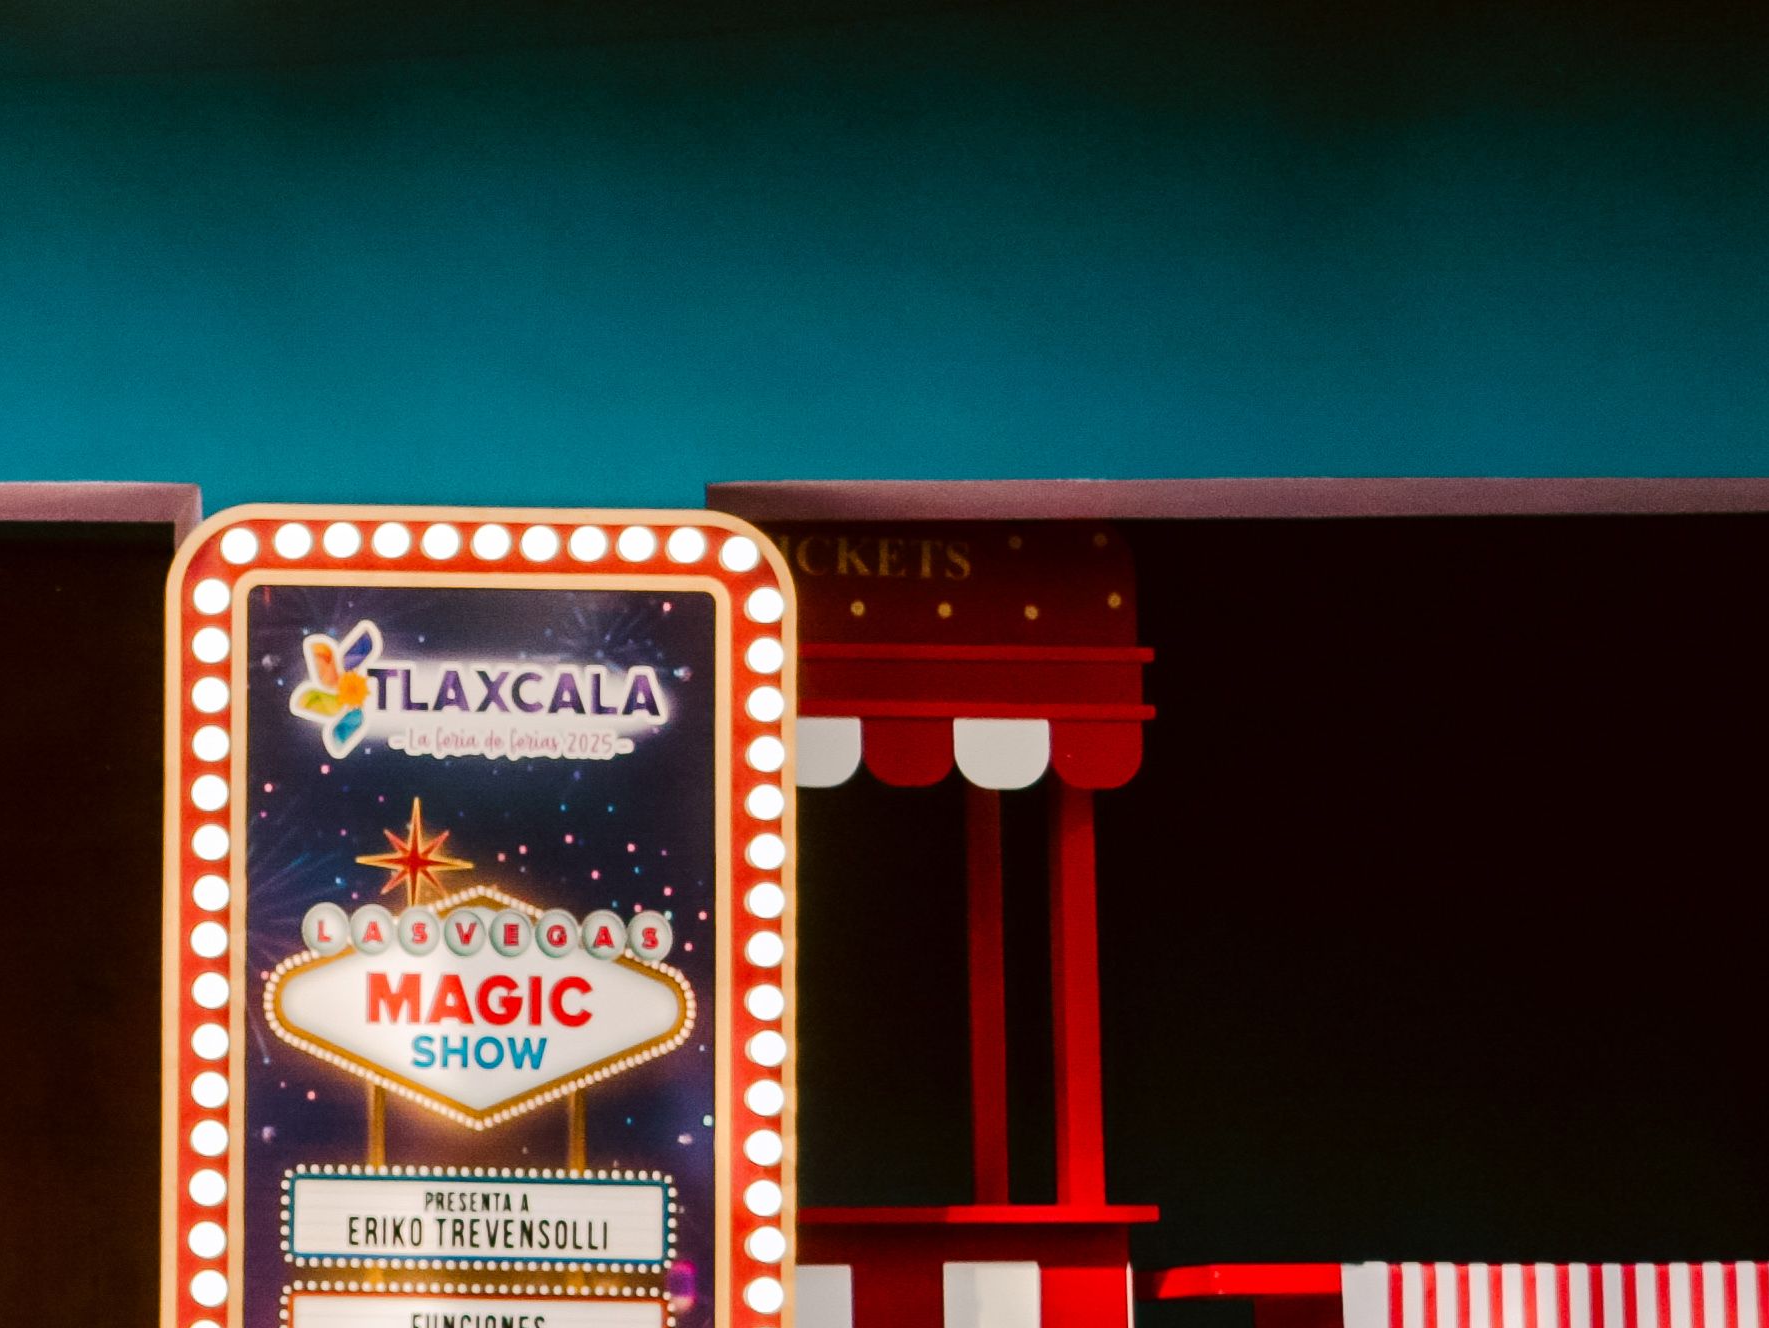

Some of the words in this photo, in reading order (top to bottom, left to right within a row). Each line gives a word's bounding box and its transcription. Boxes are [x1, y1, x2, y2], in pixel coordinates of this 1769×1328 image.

[778, 534, 972, 581] ICKETS
[367, 668, 662, 717] TLAXCALA
[409, 728, 429, 749] La
[436, 726, 478, 753] feria
[484, 729, 502, 752] de
[510, 729, 559, 753] ferias
[568, 733, 612, 753] 2025
[365, 971, 594, 1029] MAGIC
[411, 1035, 548, 1071] SHOW
[425, 1191, 512, 1213] PRESENTA
[520, 1193, 529, 1212] A
[348, 1216, 423, 1247] ERIKO
[435, 1218, 608, 1251] TREVENSOLLI
